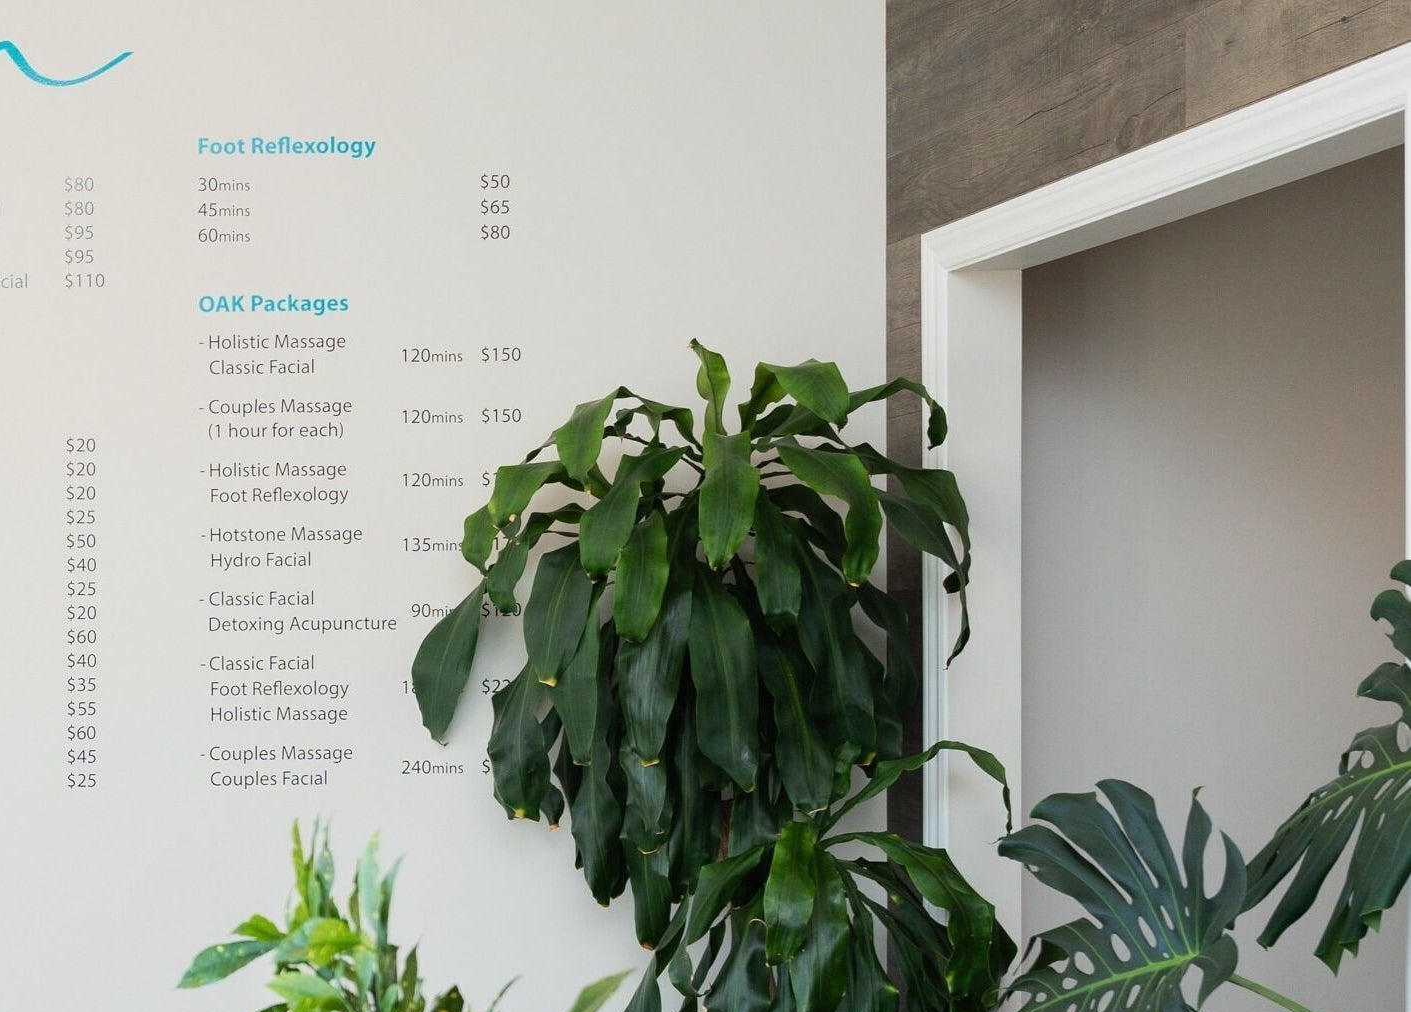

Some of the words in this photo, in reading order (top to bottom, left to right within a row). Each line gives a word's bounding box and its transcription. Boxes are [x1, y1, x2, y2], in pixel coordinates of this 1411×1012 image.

[199, 138, 245, 154] Foot
[252, 136, 376, 158] Reflexology
[199, 178, 250, 191] 30mins
[481, 174, 510, 189] $50
[65, 201, 94, 216] $80
[198, 203, 250, 216] 45mins
[481, 199, 509, 215] $65
[199, 228, 250, 242] 60mins
[481, 225, 510, 240] $80
[66, 273, 104, 288] $110
[199, 296, 244, 312] OAK
[252, 294, 348, 316] Packages
[209, 334, 269, 349] Holistic
[275, 334, 345, 352] Massage
[403, 349, 462, 362] 120mins
[482, 347, 521, 363] $150
[210, 360, 264, 374] Classic
[270, 359, 314, 374] Facial
[209, 399, 275, 417] Couples
[281, 399, 352, 416] Massage
[403, 410, 463, 423] 120mins
[482, 408, 521, 424] $150
[209, 424, 220, 440] (1
[229, 424, 267, 437] hour
[272, 423, 294, 437] for
[300, 422, 343, 438] each)
[67, 438, 95, 453] $20
[210, 463, 269, 477] Holistic
[276, 462, 346, 480] Massage
[403, 473, 463, 487] 120mins
[211, 489, 247, 502] Foot
[253, 486, 348, 504] Reflexology
[67, 509, 95, 525] $25
[67, 533, 95, 549] $50
[211, 528, 285, 542] Hotstone
[292, 527, 362, 544] Massage
[68, 557, 96, 573] $40
[212, 552, 260, 571] Hydro
[267, 552, 310, 566] Facial
[210, 592, 263, 606] Classic
[270, 590, 313, 605] Facial
[68, 605, 96, 620] $20
[209, 617, 283, 635] Detoxing
[290, 617, 396, 634] Acupuncture
[68, 629, 96, 644] $60
[270, 655, 313, 670] Facial
[68, 677, 96, 693] $35
[211, 682, 247, 696] Foot
[253, 680, 349, 699] Reflexology
[68, 701, 95, 716] $55
[211, 707, 271, 721] Holistic
[277, 707, 347, 724] Massage
[68, 725, 95, 741] $60
[68, 749, 96, 764] $45
[210, 746, 276, 764] Couples
[282, 746, 352, 763] Massage
[402, 760, 463, 774] 240mins
[211, 771, 277, 789] Couples
[283, 770, 327, 785] Facial
